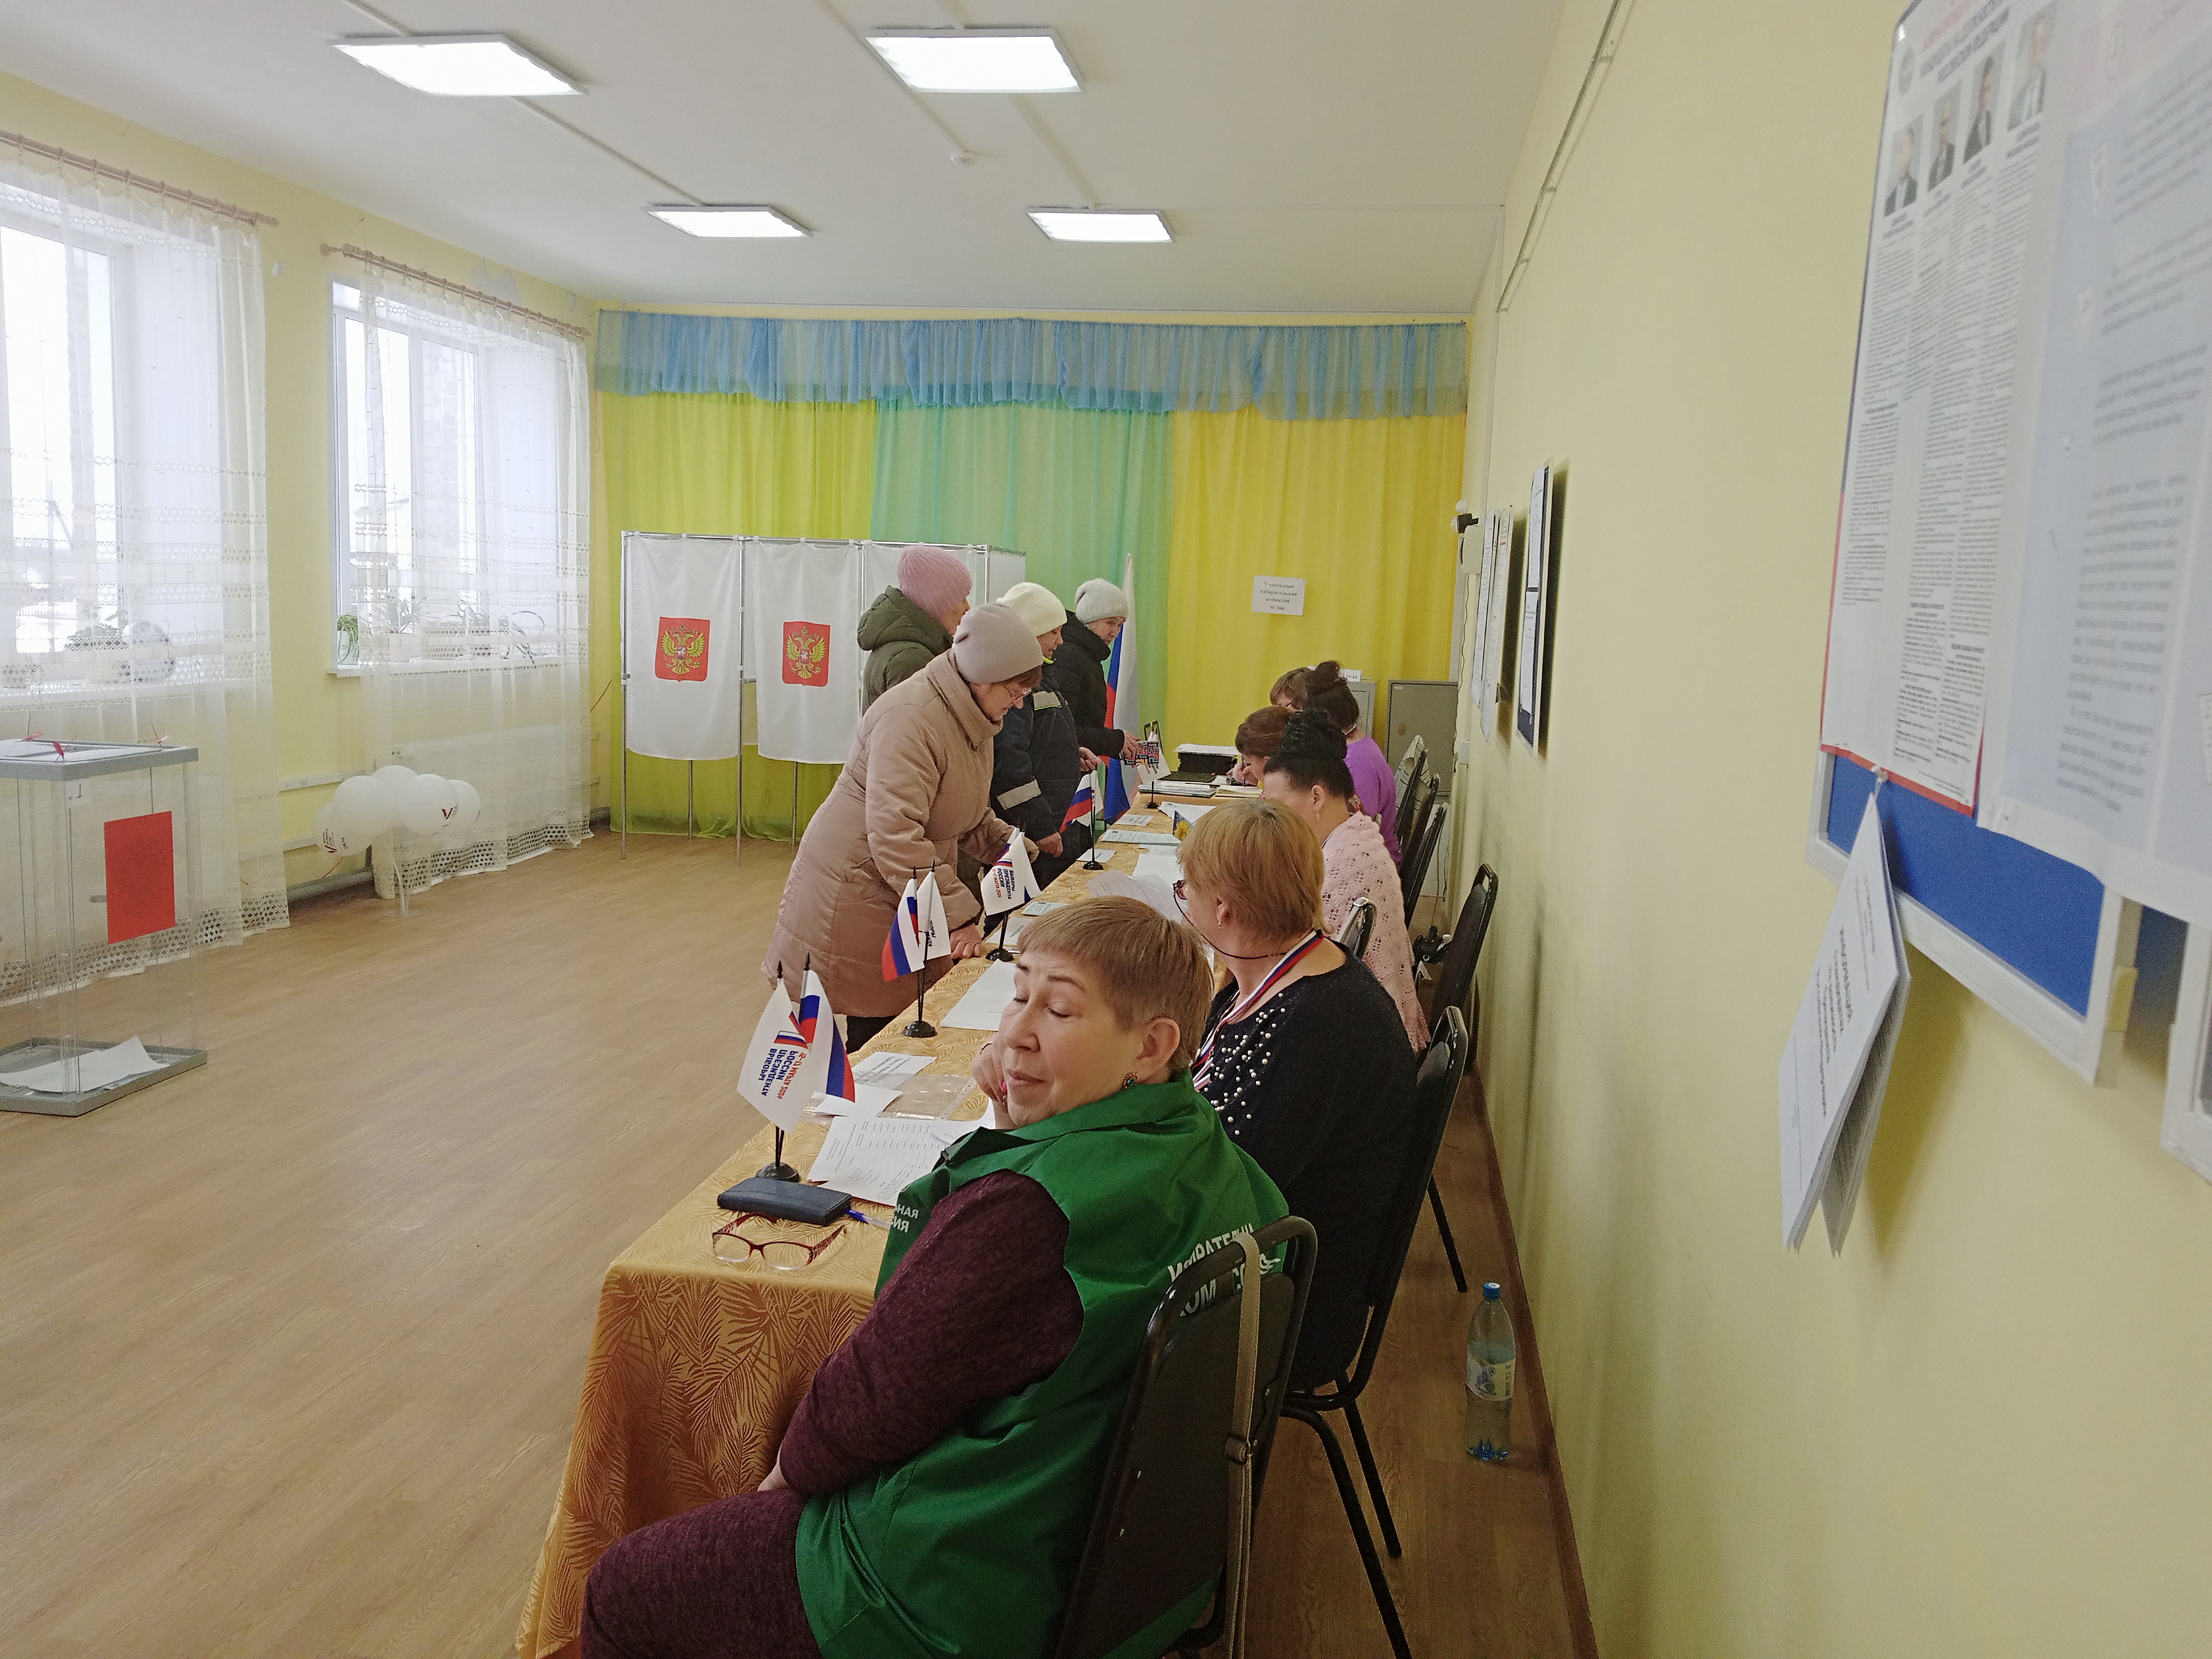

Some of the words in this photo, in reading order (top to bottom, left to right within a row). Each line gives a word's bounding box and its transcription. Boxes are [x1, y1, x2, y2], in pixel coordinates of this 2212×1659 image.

[1003, 869, 1011, 899] ПРЕЗИДЕНТА
[895, 1204, 919, 1219] НАЯ
[891, 1216, 909, 1233] ИЯ
